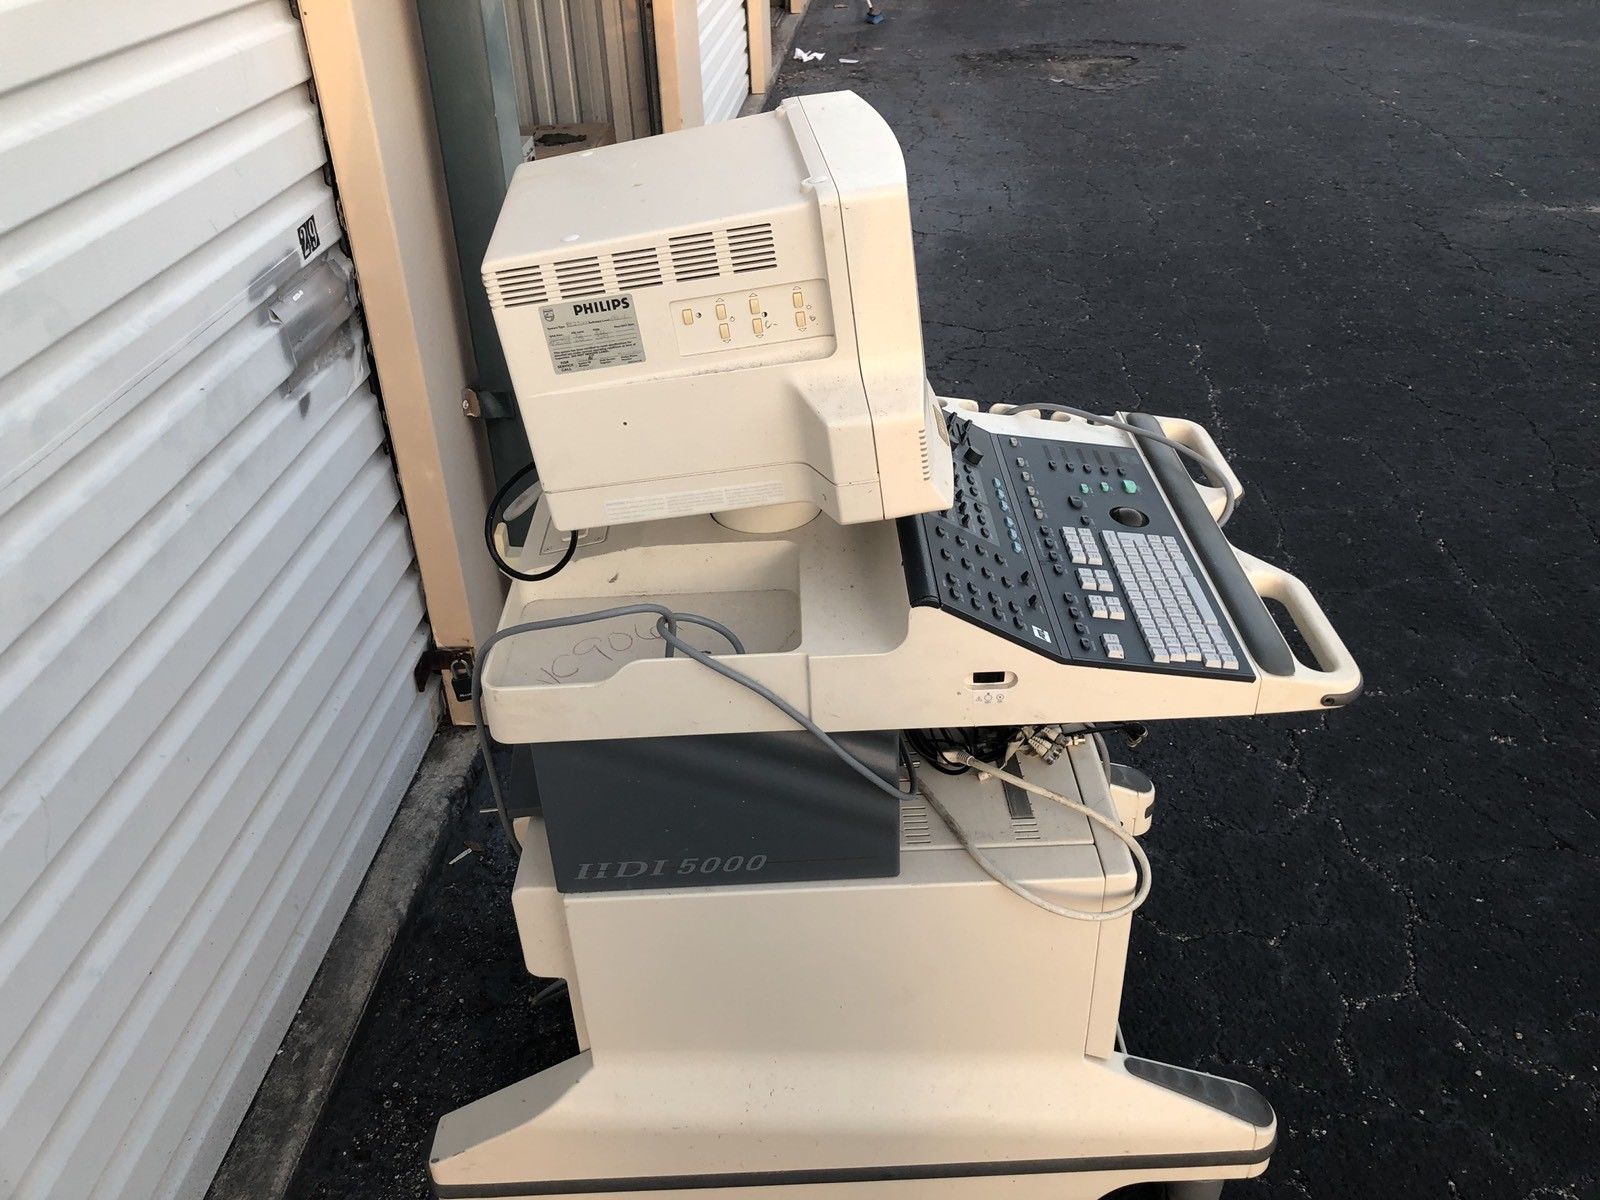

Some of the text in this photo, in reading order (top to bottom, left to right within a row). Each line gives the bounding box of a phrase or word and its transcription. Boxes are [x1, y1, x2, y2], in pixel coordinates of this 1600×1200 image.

[299, 217, 319, 258] 29
[573, 297, 630, 315] PHILIPS
[574, 854, 768, 880] HDI 5000
